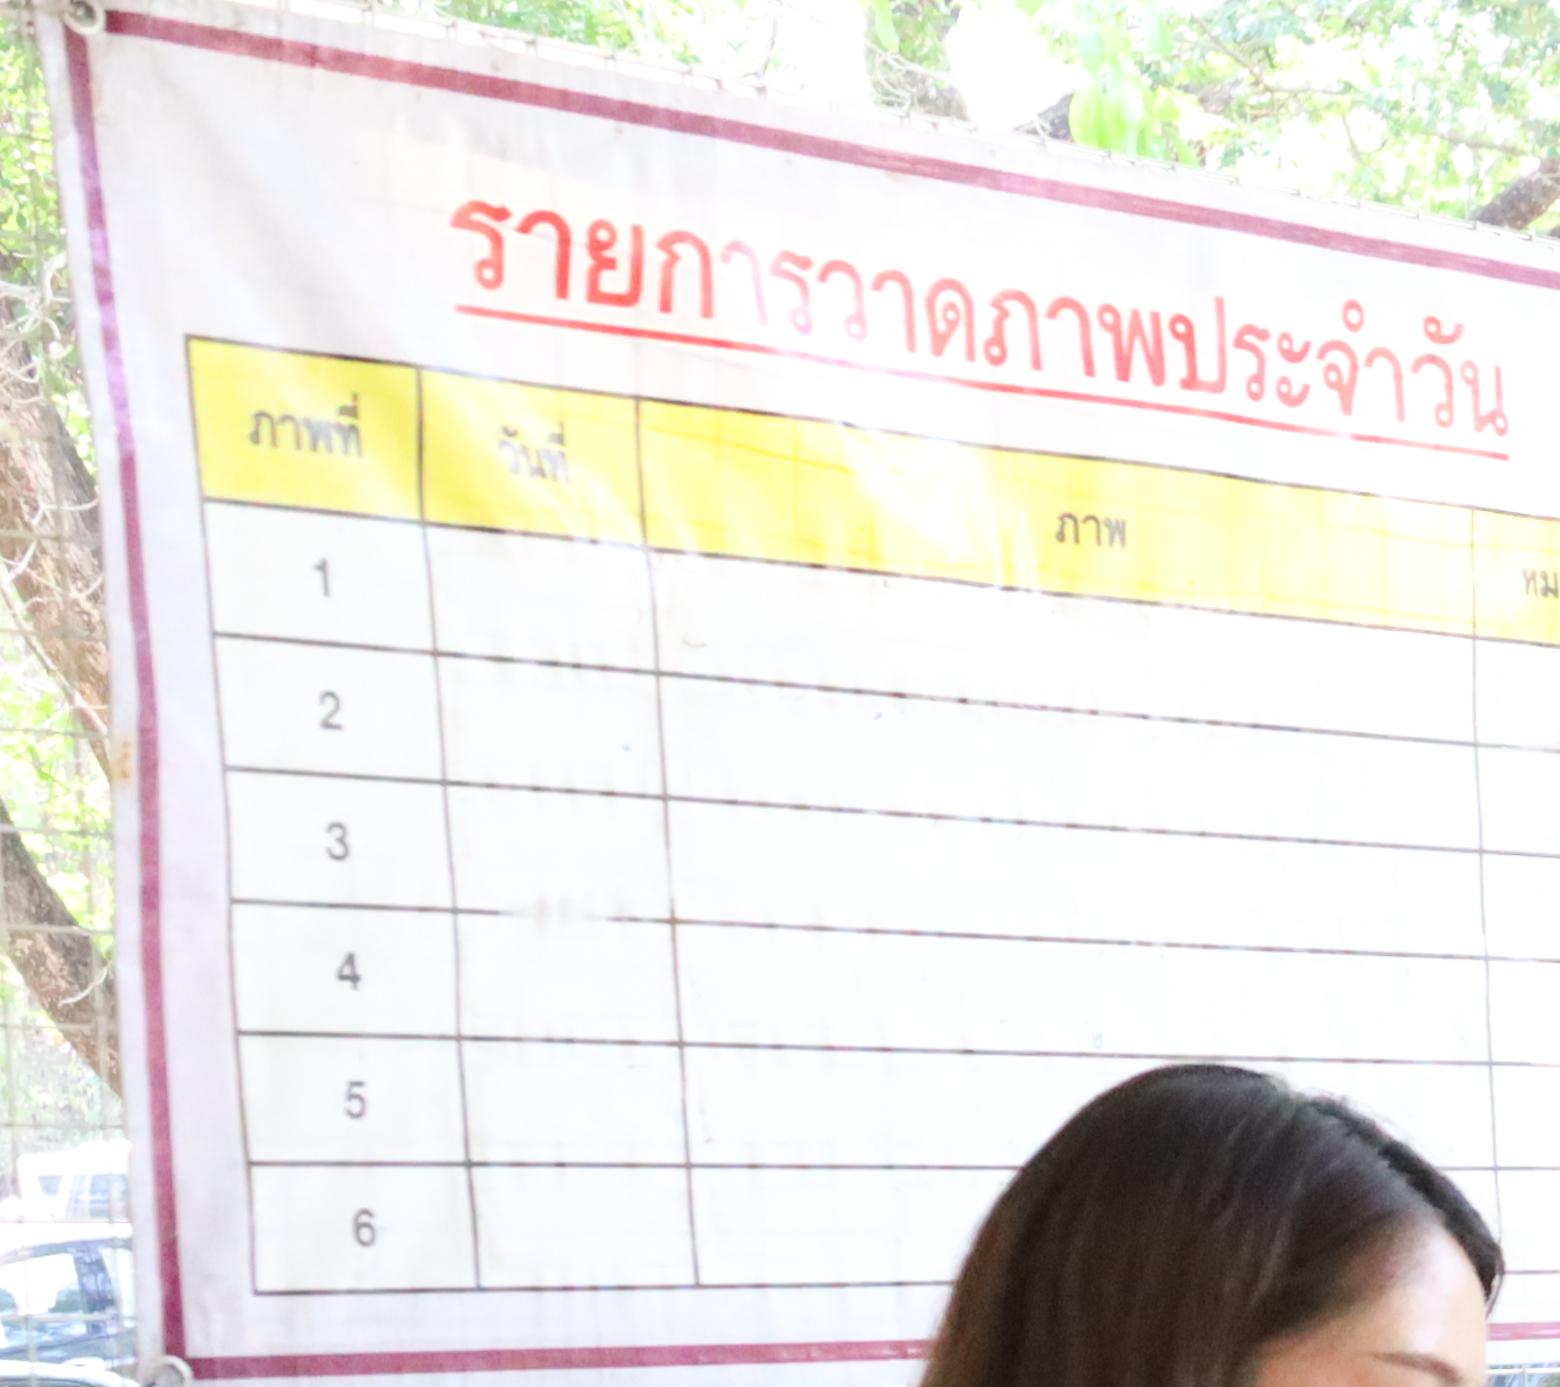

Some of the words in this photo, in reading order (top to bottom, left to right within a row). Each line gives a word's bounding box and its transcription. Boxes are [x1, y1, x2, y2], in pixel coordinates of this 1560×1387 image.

[450, 199, 1509, 437] รายการวาดภาพประจำวัน
[249, 392, 363, 458] ภาพที่
[498, 420, 571, 483] วันที่
[1055, 511, 1128, 549] ภาพ
[313, 558, 330, 597] 1
[318, 690, 343, 731] 2
[325, 822, 351, 861] 3
[336, 952, 362, 990] 4
[343, 1080, 367, 1119] 5
[351, 1208, 377, 1247] 6
